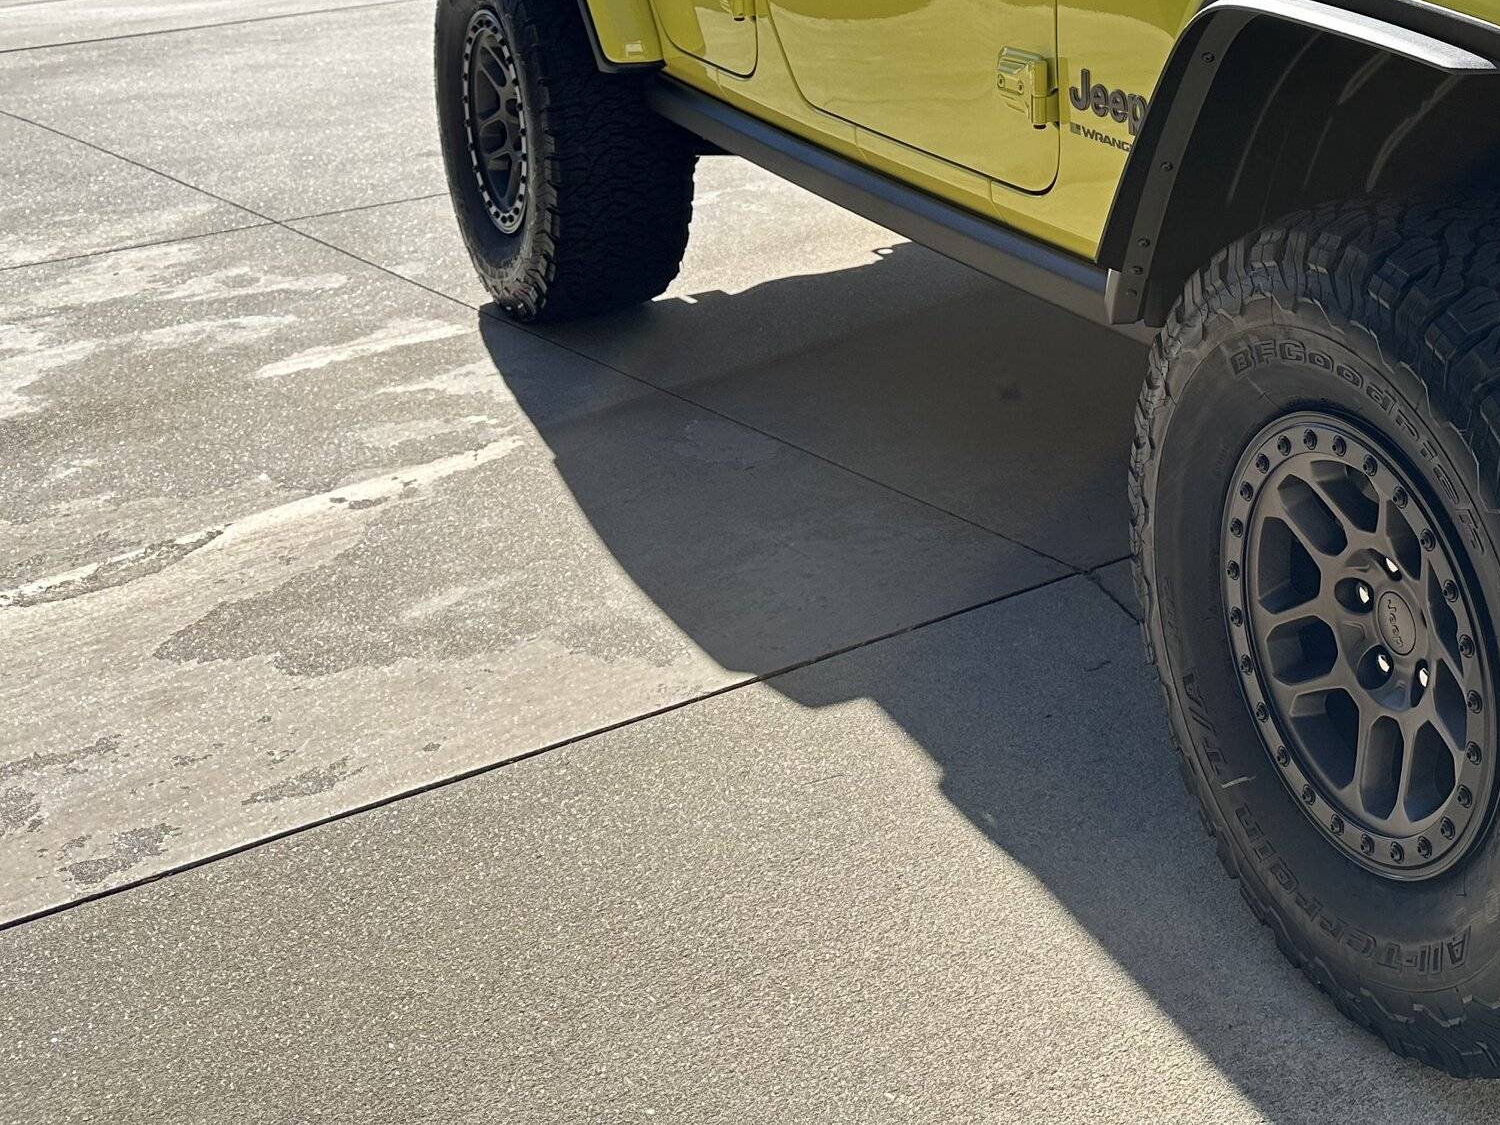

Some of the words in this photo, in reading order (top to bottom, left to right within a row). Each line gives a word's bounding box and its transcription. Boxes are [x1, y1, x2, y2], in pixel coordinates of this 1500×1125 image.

[1069, 68, 1148, 136] Jeep
[1081, 126, 1133, 152] WRANG
[1231, 339, 1485, 555] BFGoodrich
